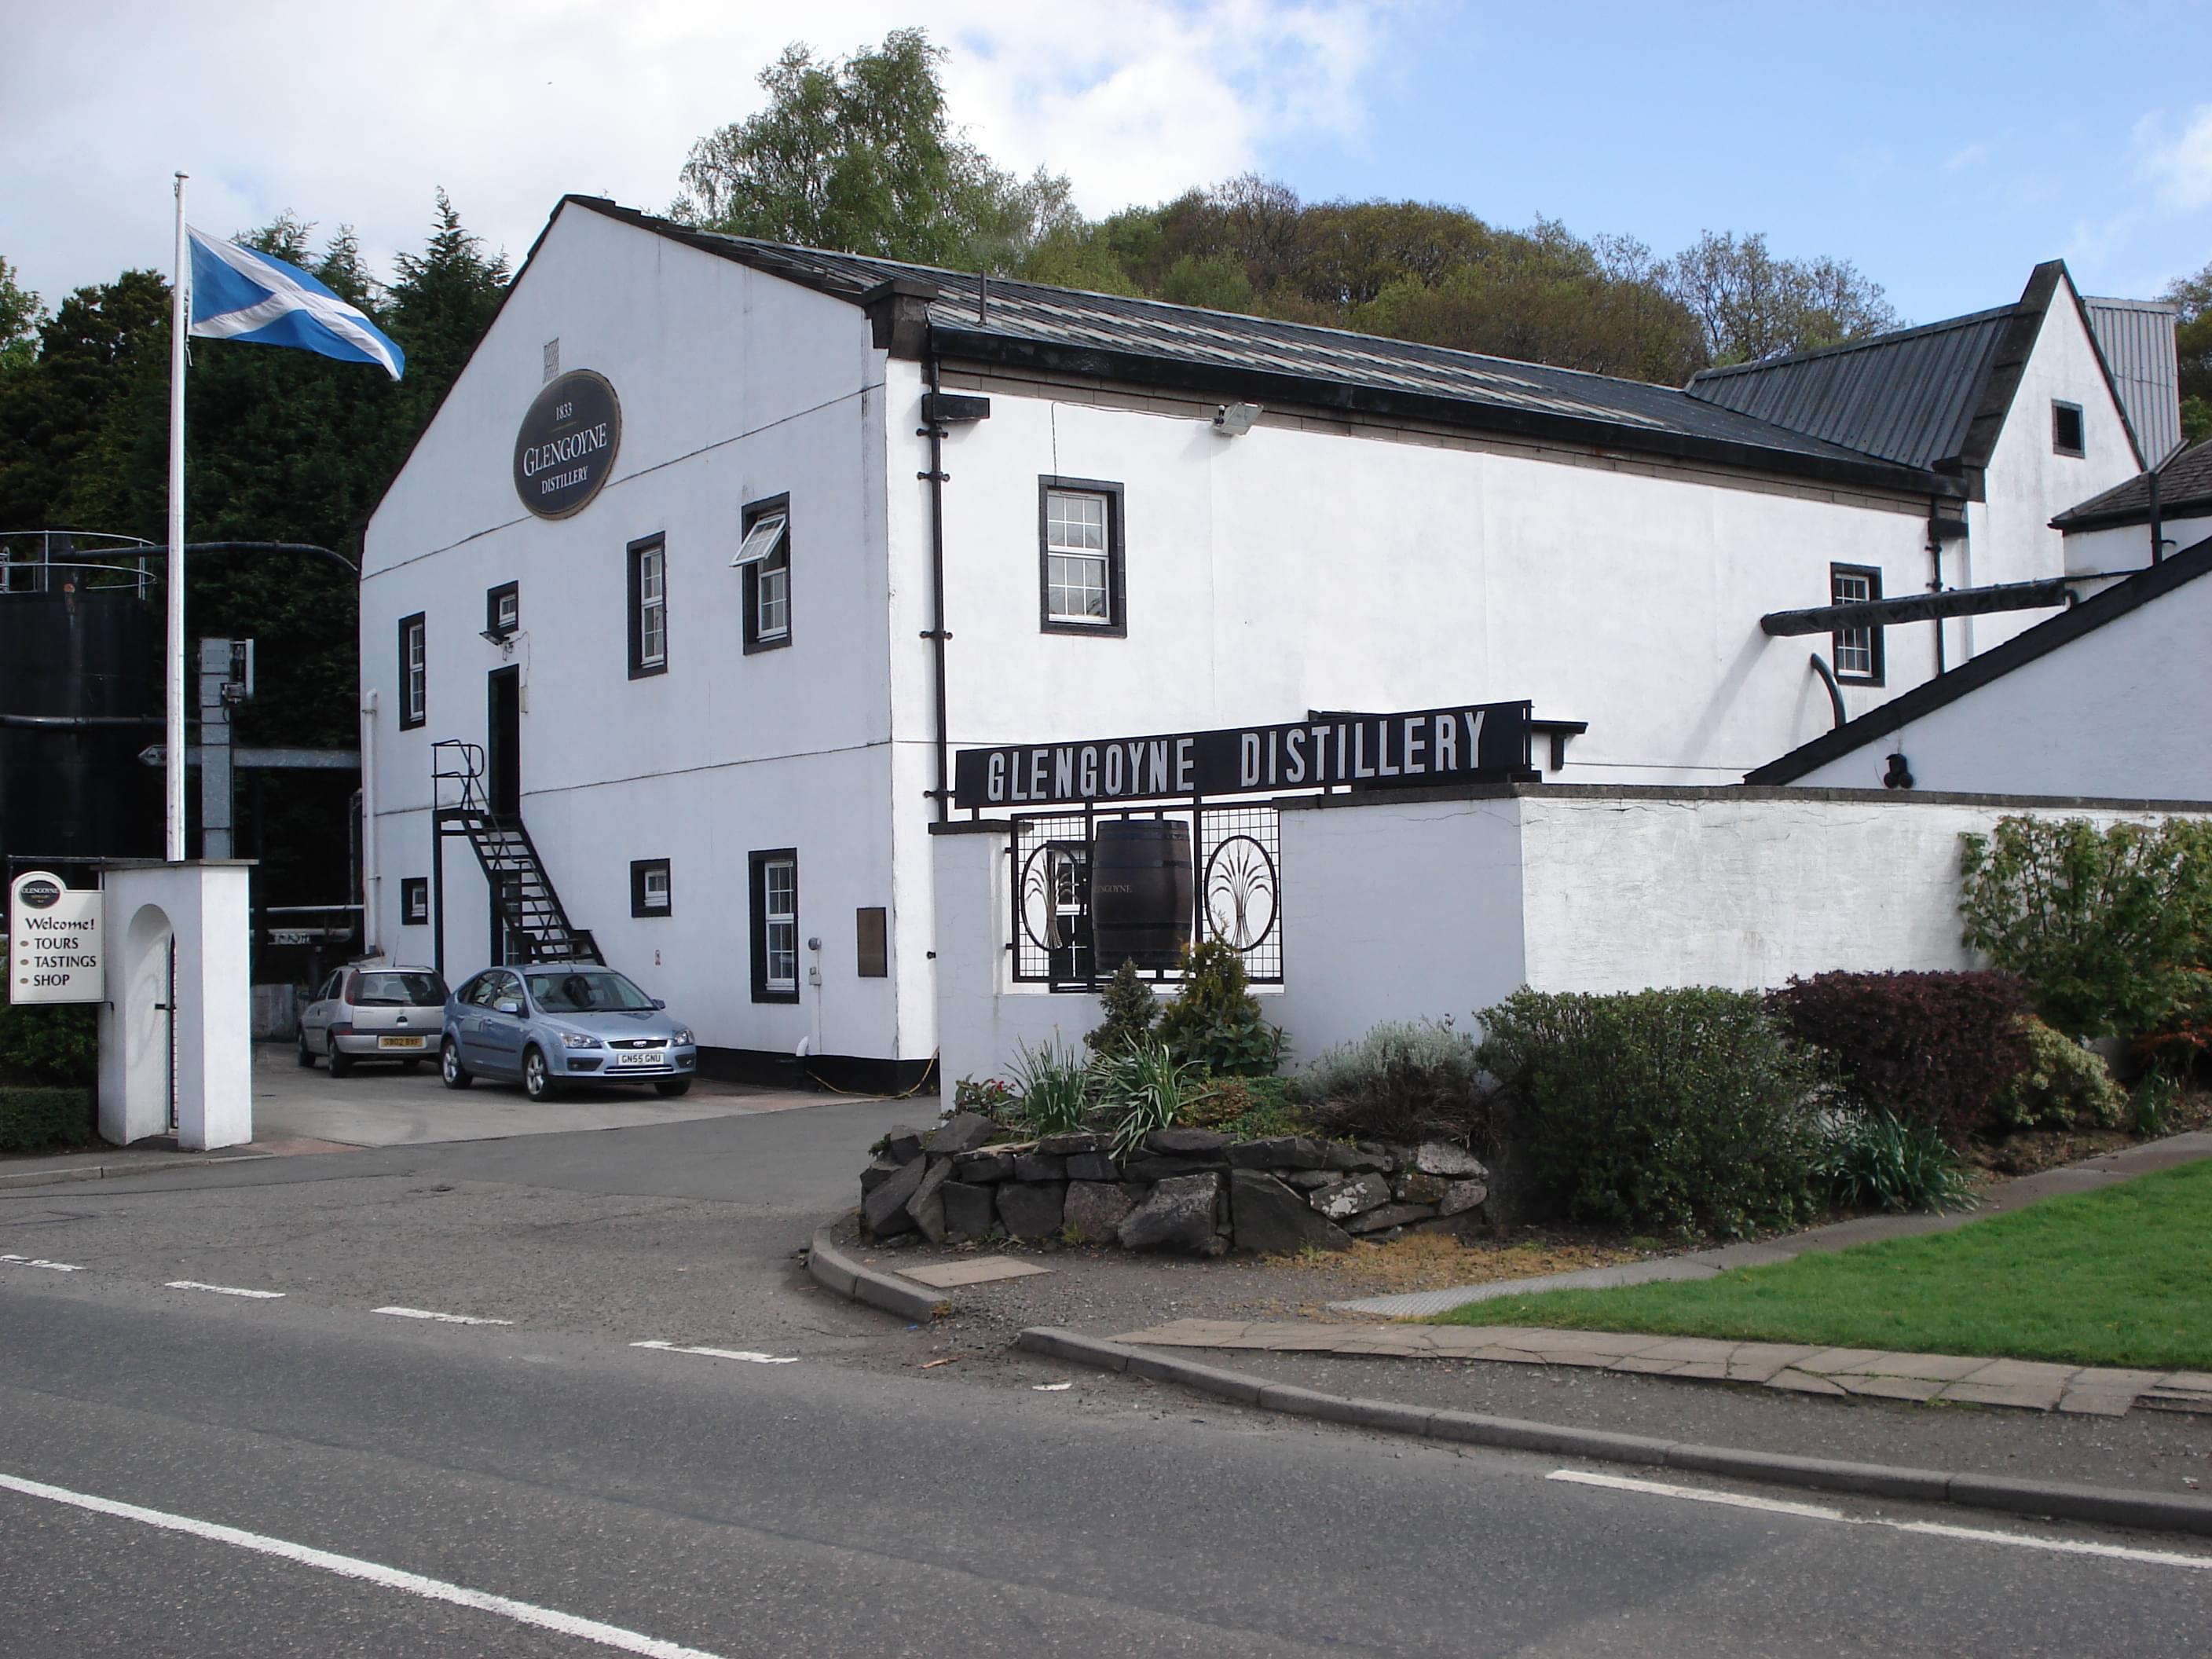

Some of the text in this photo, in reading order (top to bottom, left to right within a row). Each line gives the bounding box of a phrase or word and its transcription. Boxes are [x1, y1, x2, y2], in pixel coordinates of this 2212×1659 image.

[555, 401, 573, 421] 1833
[523, 423, 607, 477] GLENGOYNE
[541, 465, 589, 494] DISTILLERY
[987, 710, 1485, 801] GLENGOYNE DISTILLERY
[25, 917, 94, 930] Welcome!
[34, 938, 79, 950] TOURS
[34, 955, 97, 968] TASTINGS
[33, 974, 70, 987] SHOP
[621, 1054, 661, 1064] GN55 GNU
